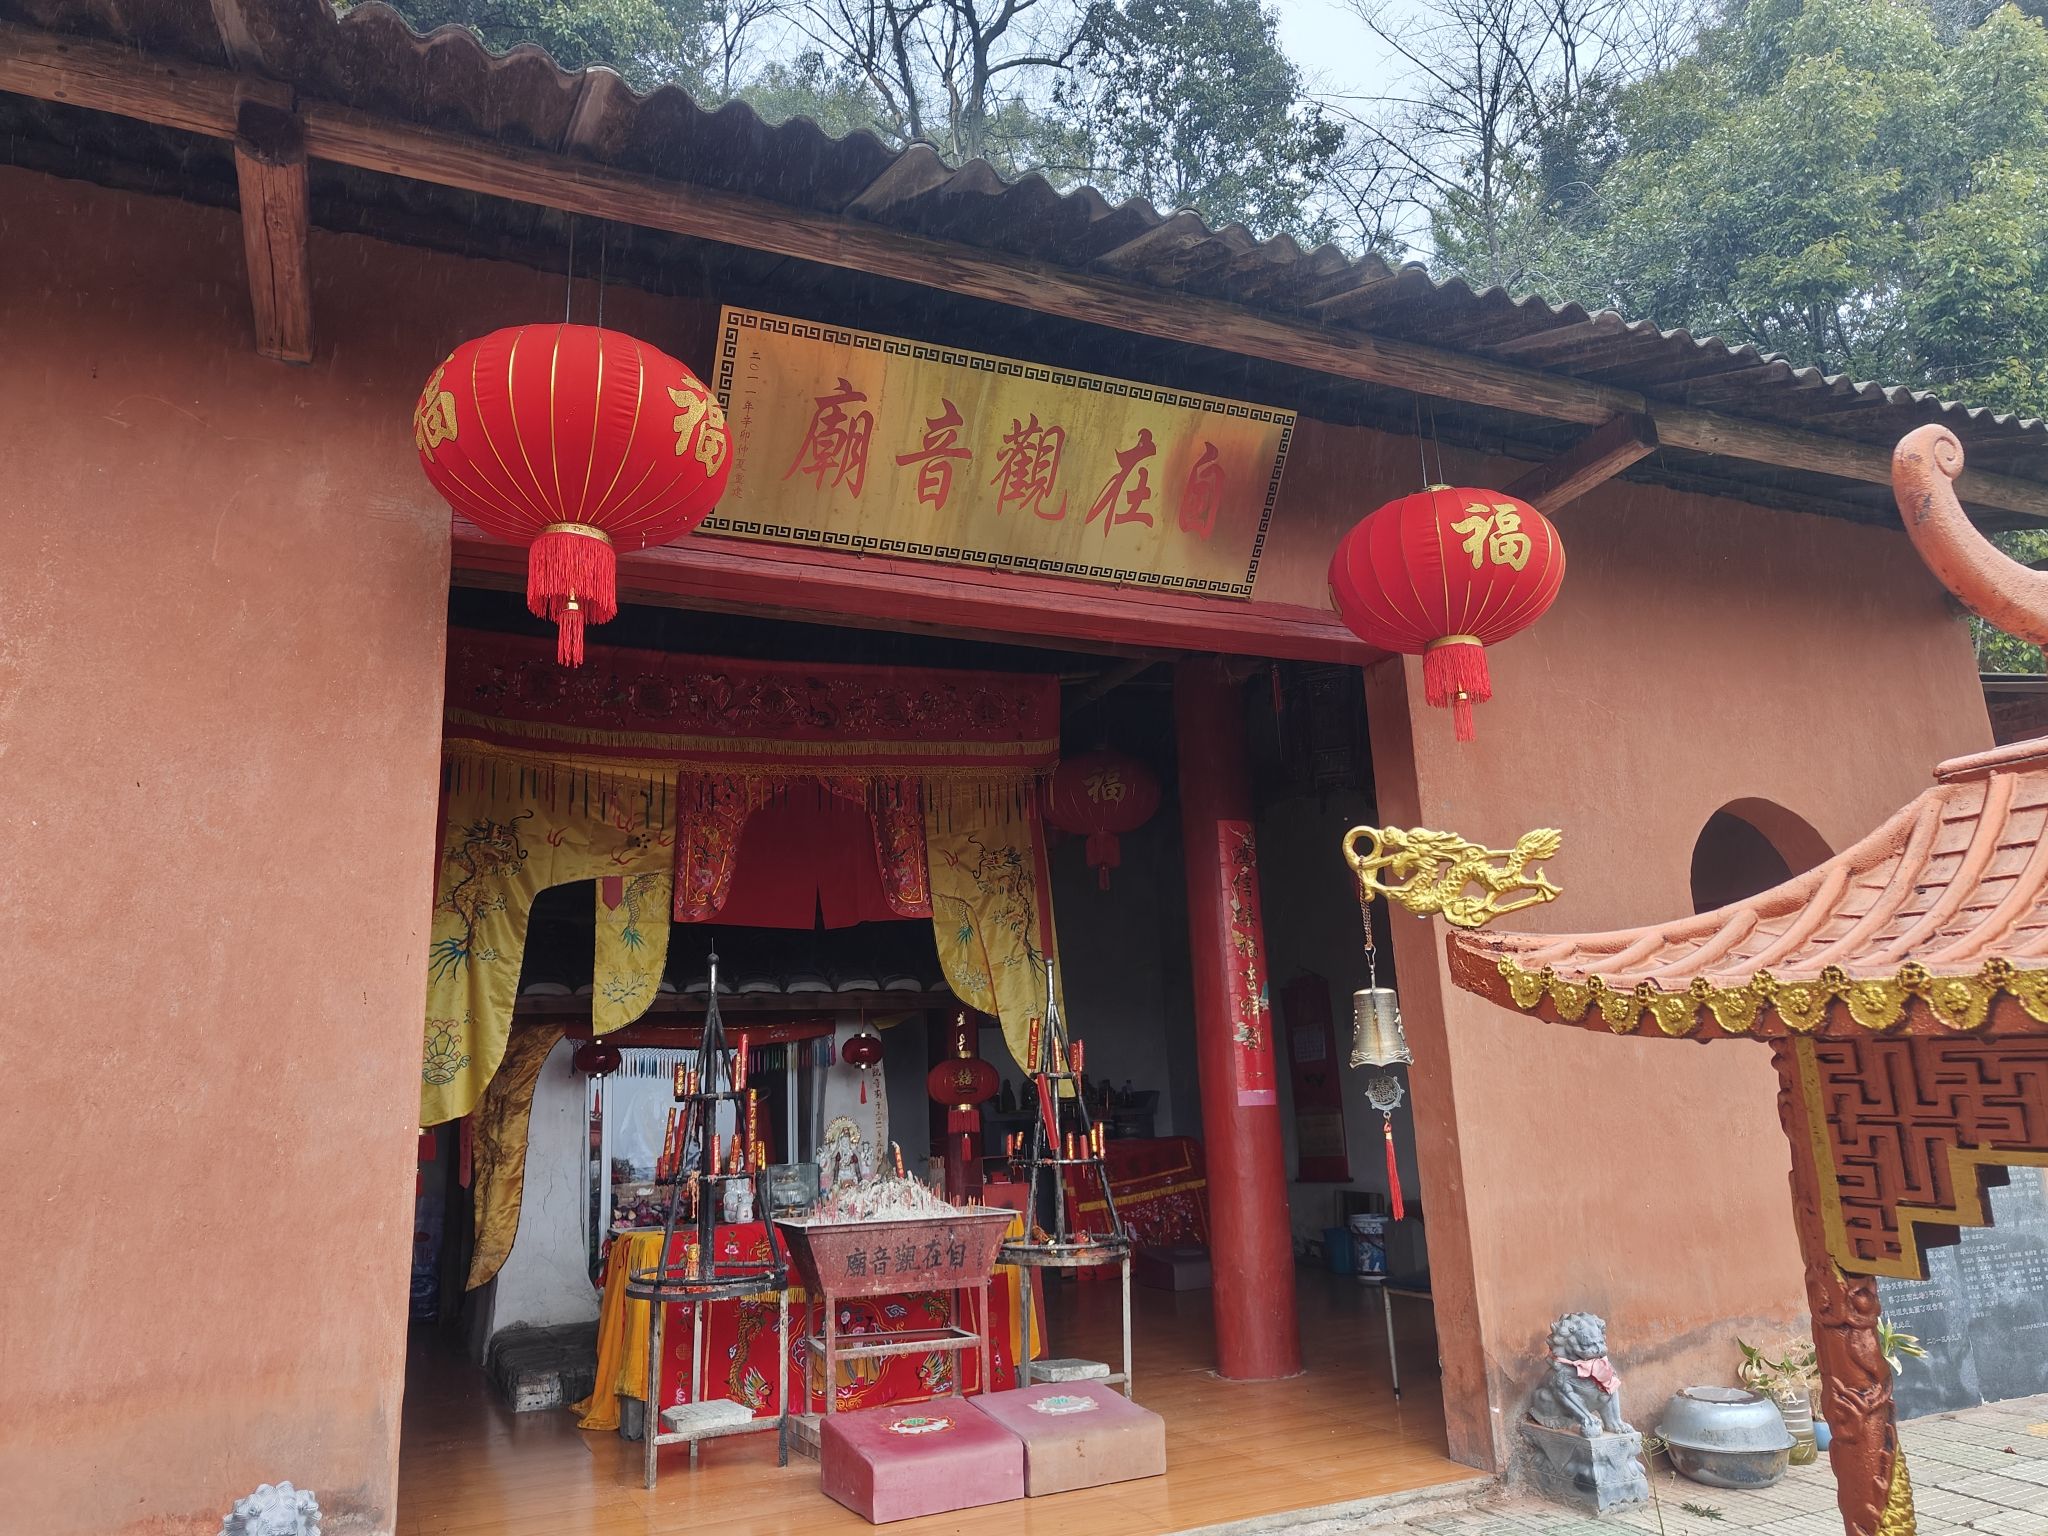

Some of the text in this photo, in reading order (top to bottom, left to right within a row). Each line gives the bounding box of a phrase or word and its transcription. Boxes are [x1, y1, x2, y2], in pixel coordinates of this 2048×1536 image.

[666, 372, 728, 478] 福
[1450, 502, 1532, 572] 福
[1082, 766, 1127, 804] 福
